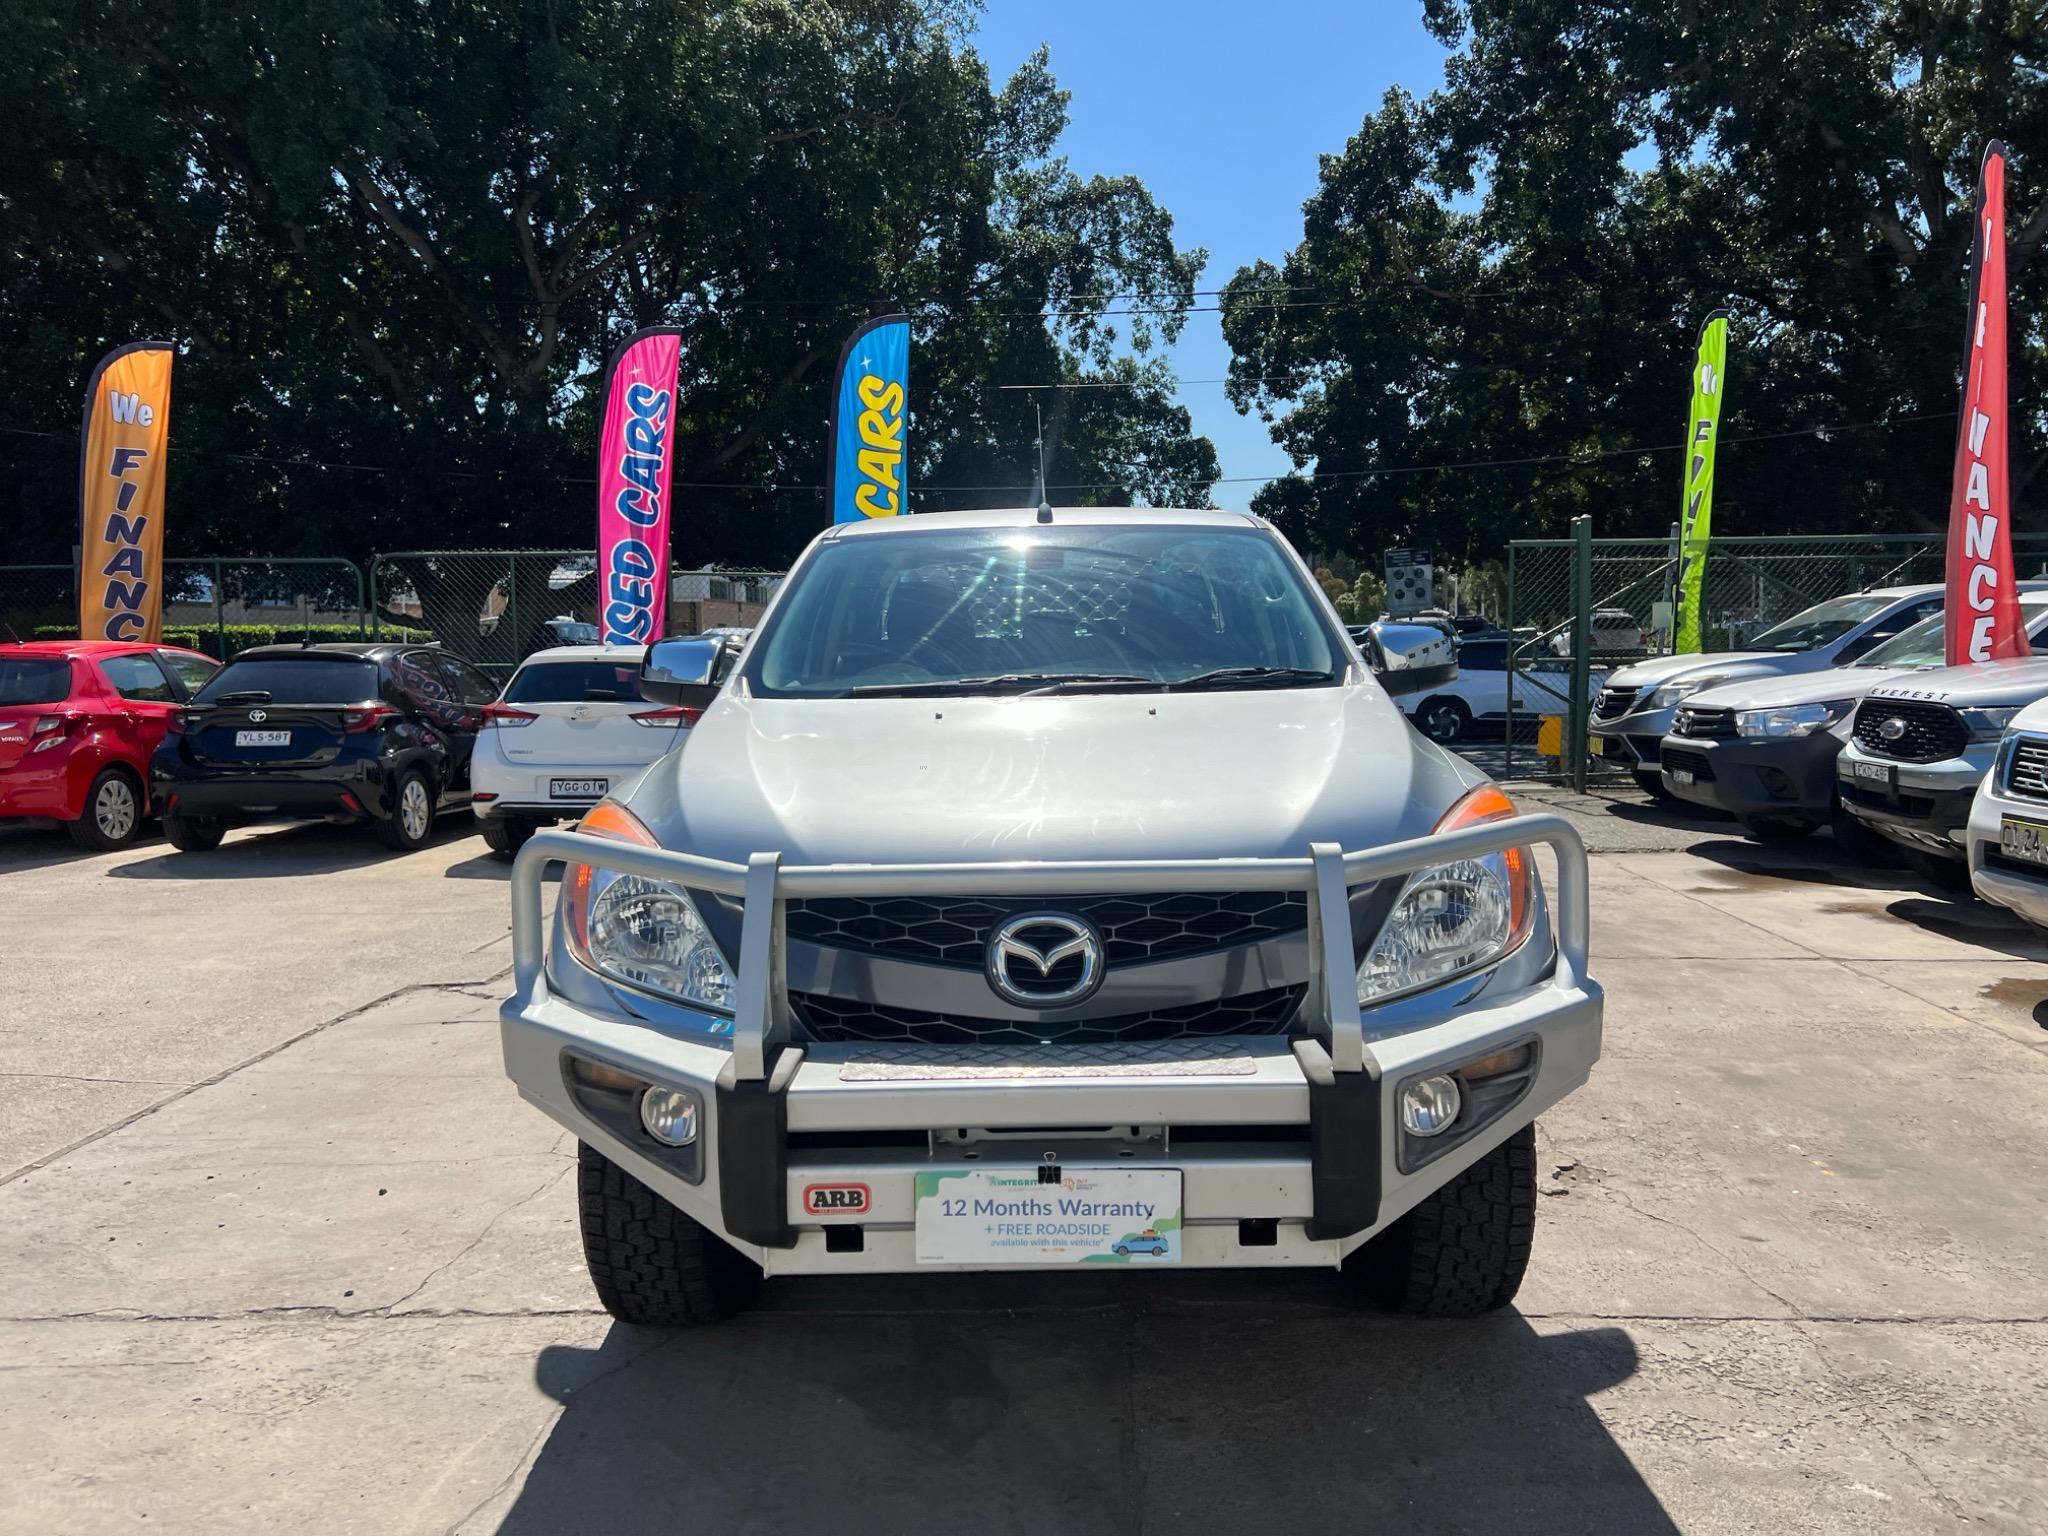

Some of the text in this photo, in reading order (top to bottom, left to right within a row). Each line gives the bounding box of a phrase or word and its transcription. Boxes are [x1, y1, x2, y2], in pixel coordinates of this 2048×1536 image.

[110, 389, 153, 427] We
[616, 382, 671, 527] CARS
[855, 374, 904, 519] CARS
[102, 448, 148, 641] FINANC
[1870, 688, 1950, 701] EVEREST
[813, 1190, 864, 1207] ARB
[941, 1198, 1155, 1220] 12 Months Warranty
[997, 1223, 1032, 1235] FREE
[1036, 1223, 1110, 1235] ROADSIDE
[990, 1238, 1022, 1247] available
[1024, 1238, 1043, 1247] with
[1048, 1238, 1066, 1247] this
